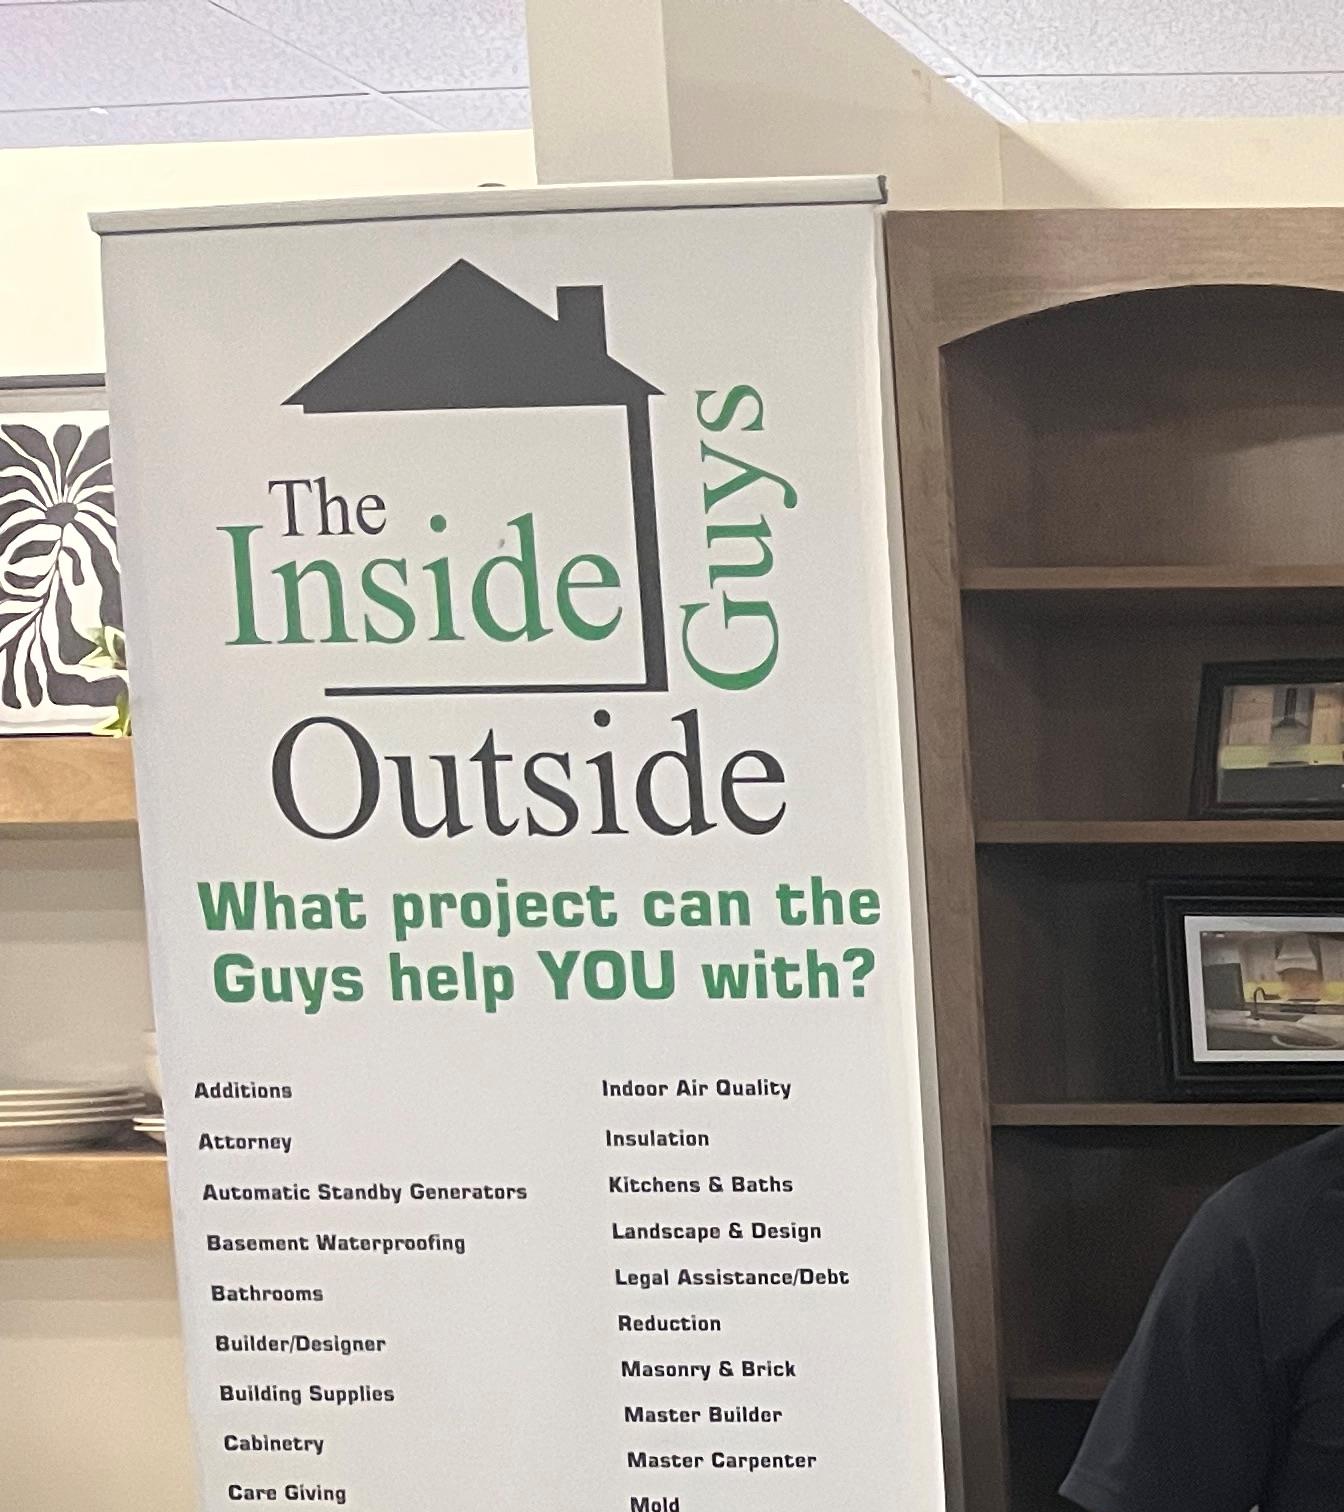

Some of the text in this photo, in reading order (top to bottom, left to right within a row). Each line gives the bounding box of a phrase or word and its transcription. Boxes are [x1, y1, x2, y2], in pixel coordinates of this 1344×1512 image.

[268, 477, 387, 537] The
[681, 383, 798, 691] Guys
[215, 512, 624, 647] Inside
[270, 708, 788, 841] Outside
[198, 875, 881, 941] What project can the
[212, 947, 877, 1016] Guys help YOU with?
[194, 1082, 292, 1098] Additions
[602, 1079, 791, 1100] Indoor Air Quality
[203, 1183, 527, 1204] Automatic Standby Generators
[609, 1175, 793, 1193] Kitchens & Baths
[207, 1234, 465, 1254] Basement Waterproofing
[615, 1268, 849, 1289] Legal Assistance/Debt
[211, 1285, 323, 1301] Bathrooms
[618, 1315, 721, 1331] Reduction
[216, 1335, 386, 1355] Builder/Designer
[625, 1406, 782, 1423] Master Builder
[224, 1434, 324, 1455] Cabinetry
[630, 1497, 680, 1512] Mold
